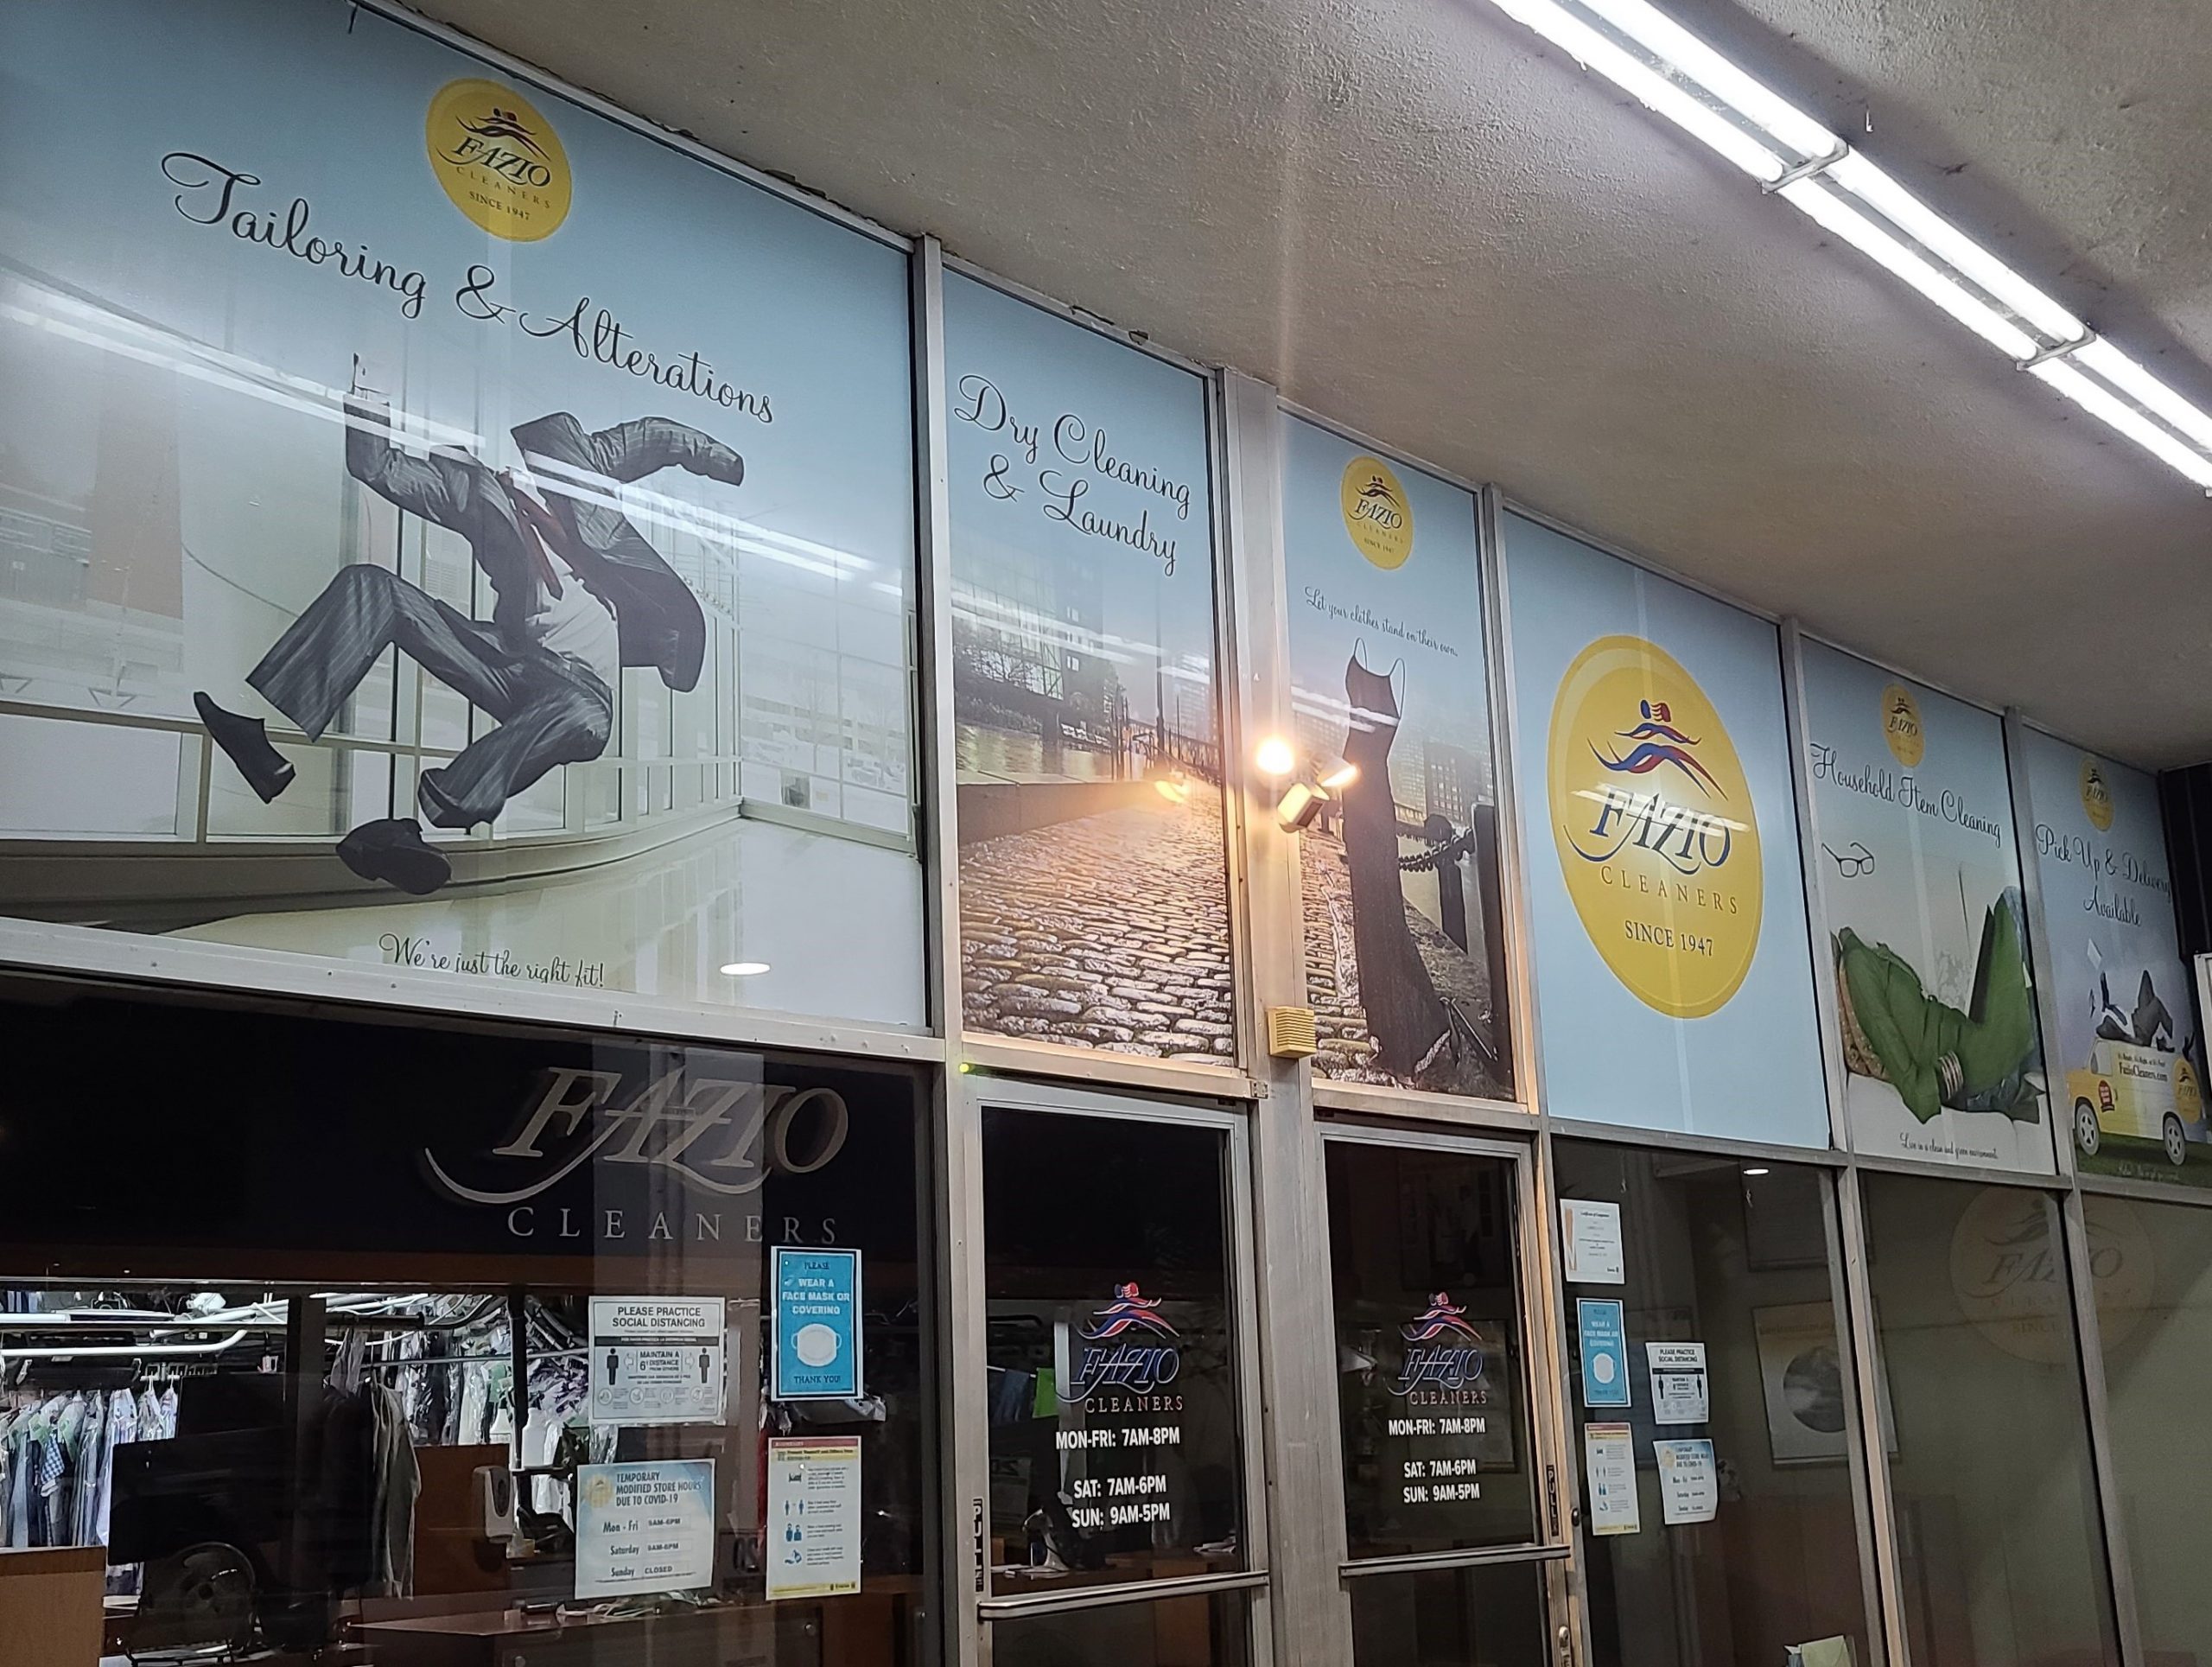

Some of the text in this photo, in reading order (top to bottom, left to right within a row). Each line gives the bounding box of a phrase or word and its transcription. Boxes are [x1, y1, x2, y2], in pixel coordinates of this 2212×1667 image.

[435, 137, 551, 188] FAZIO
[457, 166, 550, 209] CLEANERS
[469, 191, 531, 220] SINCE 1947
[161, 152, 774, 423] Tailoring & Alterations
[954, 375, 1190, 519] Dry Cleaning
[983, 455, 1176, 576] & Laundry
[1346, 499, 1402, 529] FAZIO
[1305, 587, 1325, 610] Let
[1328, 604, 1348, 620] your
[1351, 605, 1379, 629] clothes
[1382, 618, 1405, 638] stand
[1407, 632, 1417, 642] on
[1416, 629, 1439, 651] their
[1810, 743, 2000, 849] Household Item Cleaning
[1563, 786, 1731, 875] FAZIO
[2036, 824, 2071, 862] Pick
[2074, 837, 2100, 881] Up
[2105, 849, 2117, 875] &
[1600, 865, 1738, 914] CLEANERS
[2083, 885, 2141, 926] Available
[1624, 919, 1713, 957] SINCE 1947
[379, 933, 604, 987] We're just the right fit!
[423, 1066, 849, 1204] FAZIO
[507, 1206, 837, 1244] CLEANERS
[804, 1262, 830, 1270] PLEASE
[798, 1278, 834, 1287] WEAR A
[783, 1292, 849, 1301] FACE MASK OR
[613, 1318, 705, 1327] SOCIAL DISTANCING
[618, 1307, 701, 1316] PLEASE PRACTICE
[792, 1306, 840, 1314] COVERING
[1055, 1343, 1179, 1403] FAZIO
[1383, 1345, 1484, 1396] FAZIO
[1085, 1396, 1183, 1413] CLEANERS
[1409, 1390, 1487, 1405] CLEANERS
[1056, 1427, 1179, 1450] MON-FRI: 7AM-8PM
[1389, 1417, 1486, 1435] MON-FRI: 7AM-8PM
[617, 1473, 660, 1483] TEMPORARY
[1404, 1459, 1477, 1478] SAT: 7AM-6PM
[616, 1484, 651, 1494] MODIFIED
[654, 1482, 676, 1492] STORE
[1074, 1474, 1166, 1498] SAT: 7AM-6PM
[1403, 1483, 1480, 1503] SUN: 9AM-5PM
[616, 1493, 678, 1506] DUE TO COVID-19
[603, 1522, 620, 1533] Mon
[629, 1521, 639, 1531] Fri
[1071, 1503, 1170, 1528] SUN: 9AM-5PM
[611, 1545, 639, 1556] Saturday
[611, 1567, 634, 1578] Sunday
[645, 1565, 672, 1574] CLOSED
